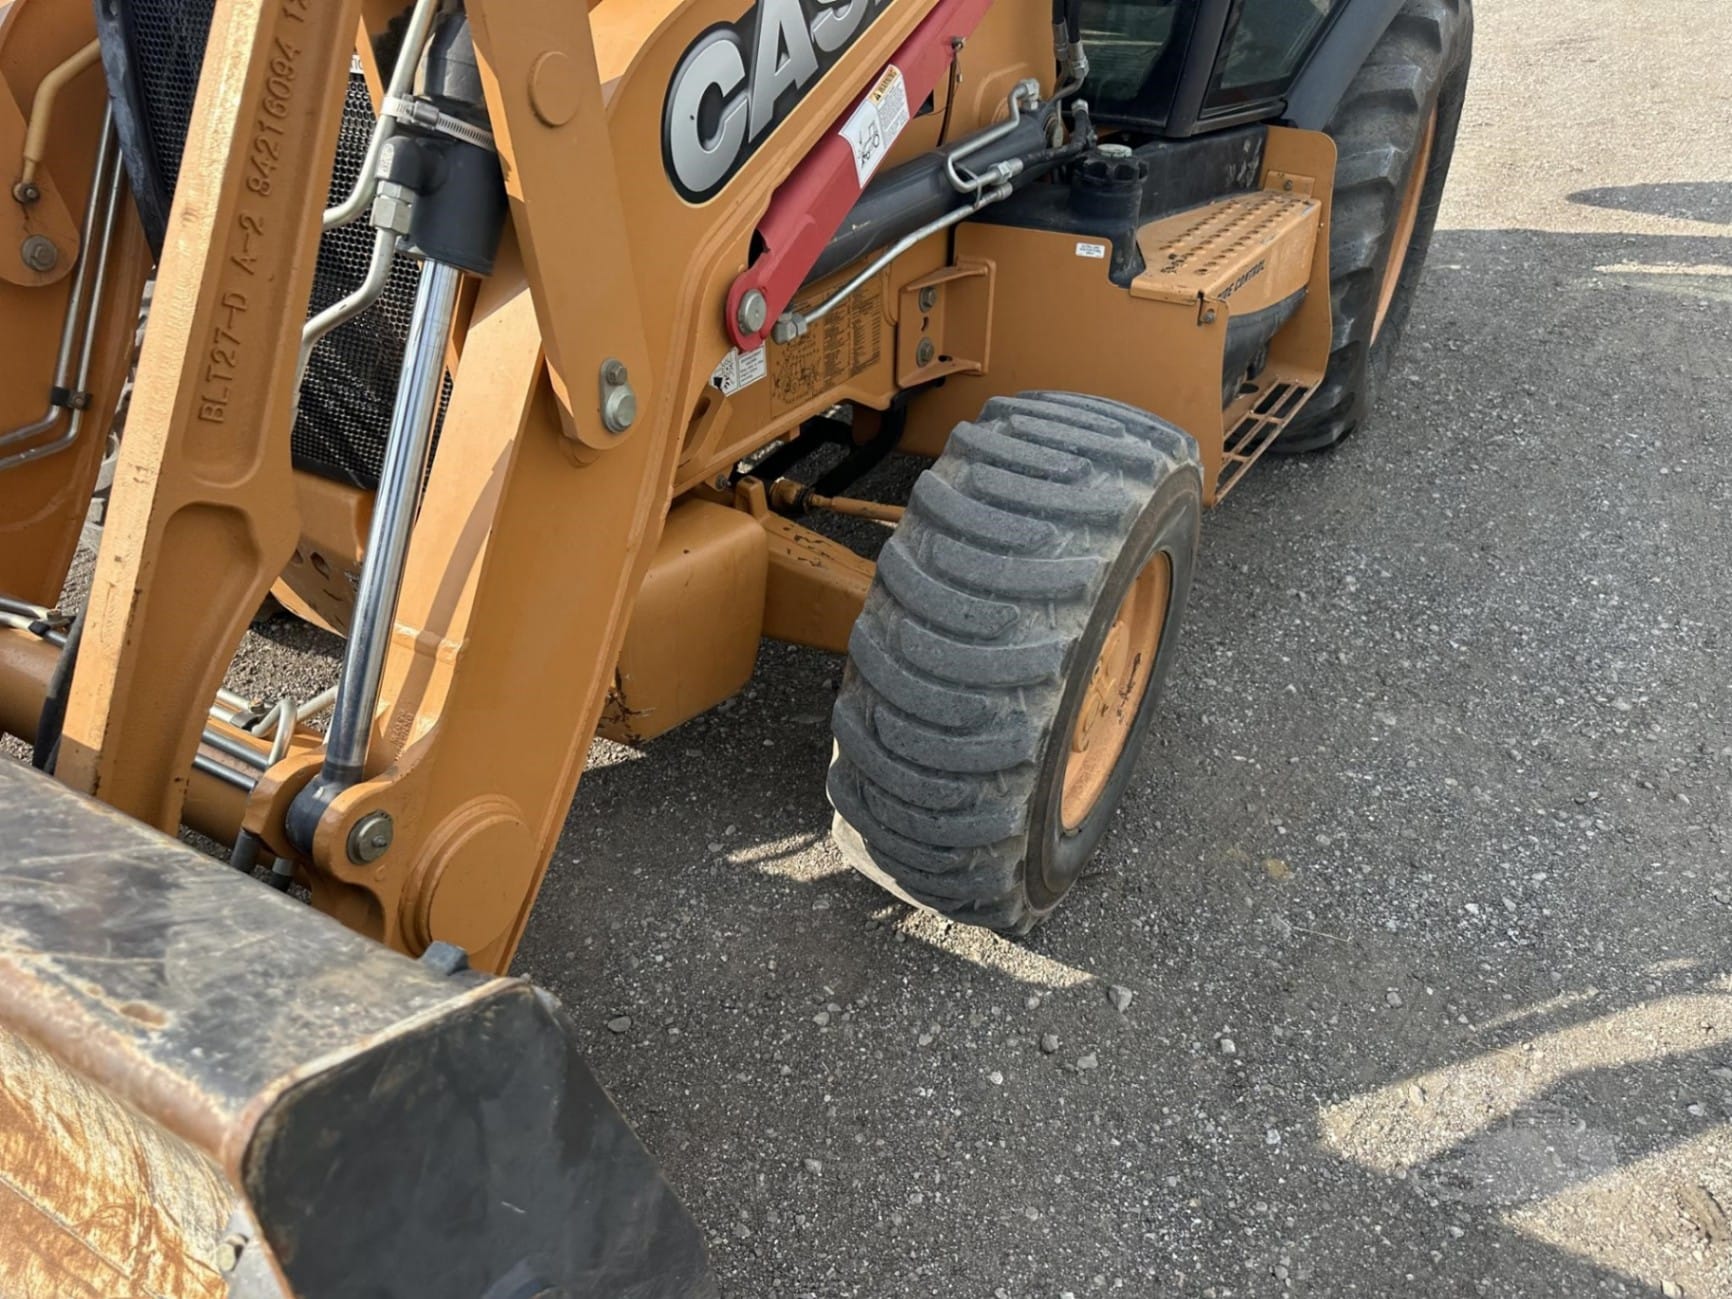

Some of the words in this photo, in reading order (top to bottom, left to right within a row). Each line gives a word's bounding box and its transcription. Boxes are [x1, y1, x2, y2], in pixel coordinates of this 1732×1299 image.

[246, 36, 301, 197] 84216094
[667, 0, 882, 192] CAS
[231, 212, 264, 276] A-2
[198, 291, 247, 424] BLT27-D
